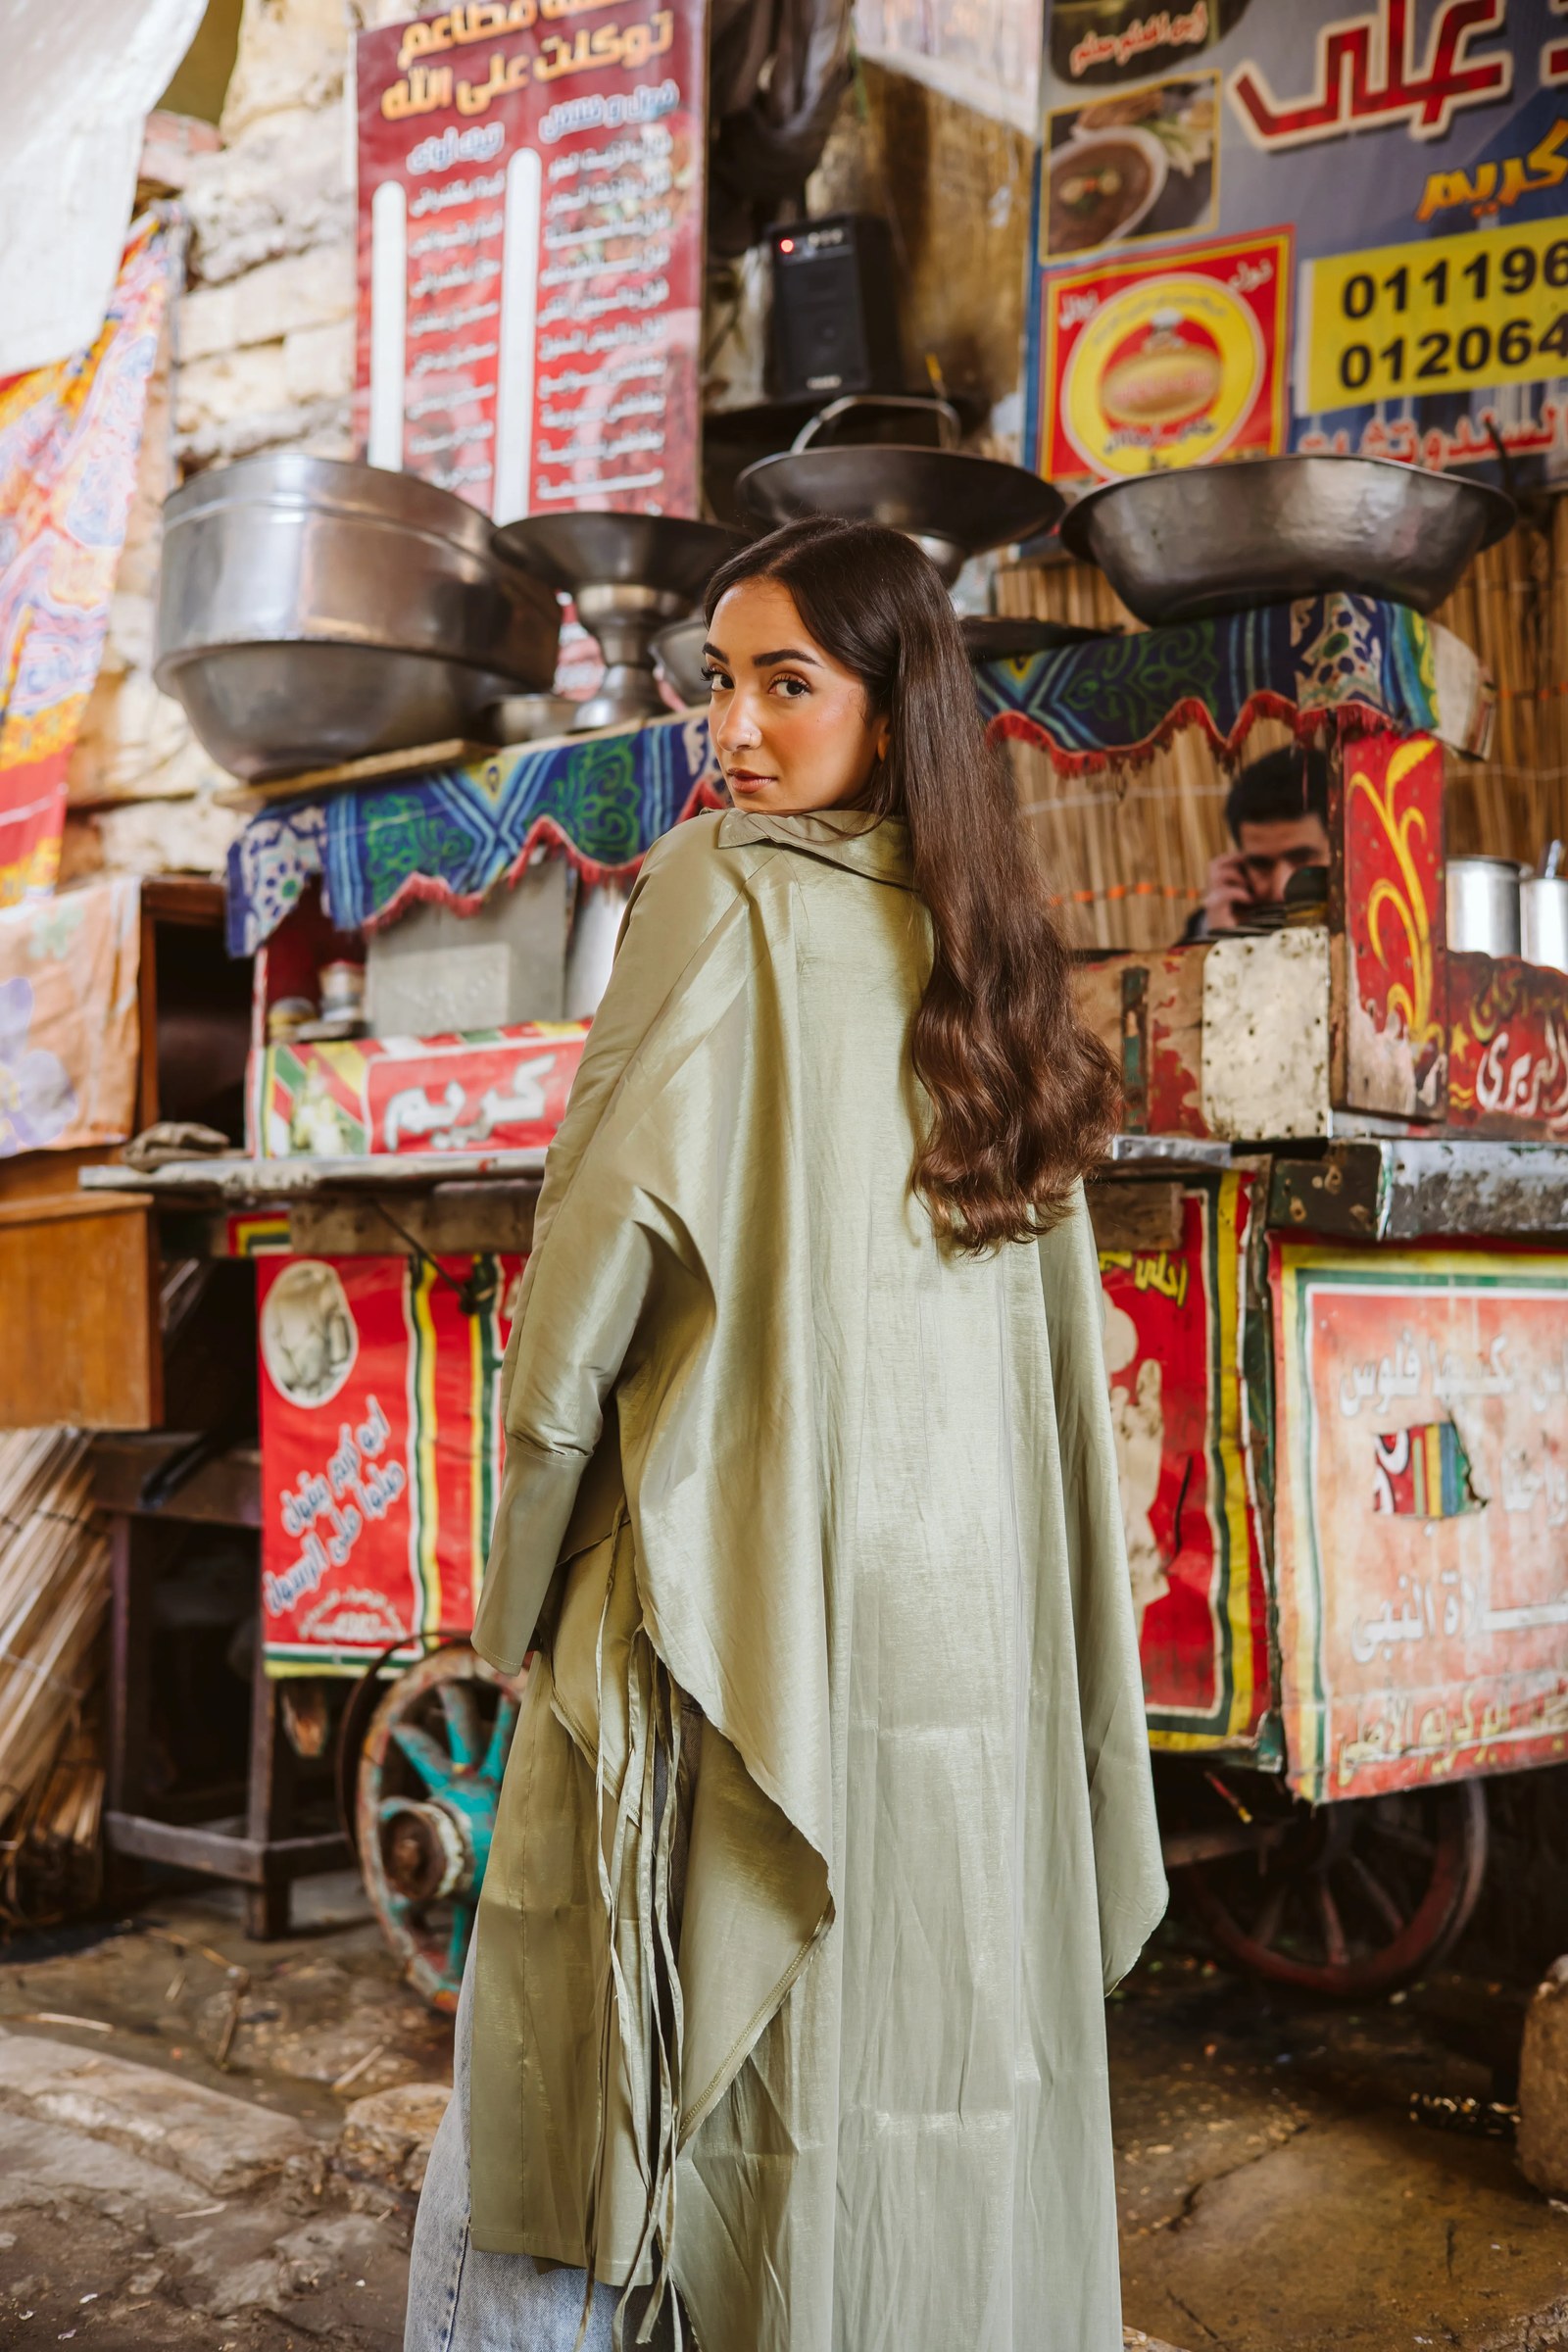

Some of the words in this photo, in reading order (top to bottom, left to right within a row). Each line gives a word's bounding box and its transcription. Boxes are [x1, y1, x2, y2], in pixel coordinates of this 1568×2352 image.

[533, 9, 674, 82] توكلت
[380, 65, 454, 121] الله
[456, 54, 530, 116] على
[1341, 239, 1568, 320] 011196
[1340, 312, 1568, 390] 012064
[384, 1054, 557, 1152] كريم
[1340, 1327, 1420, 1416] فلوس
